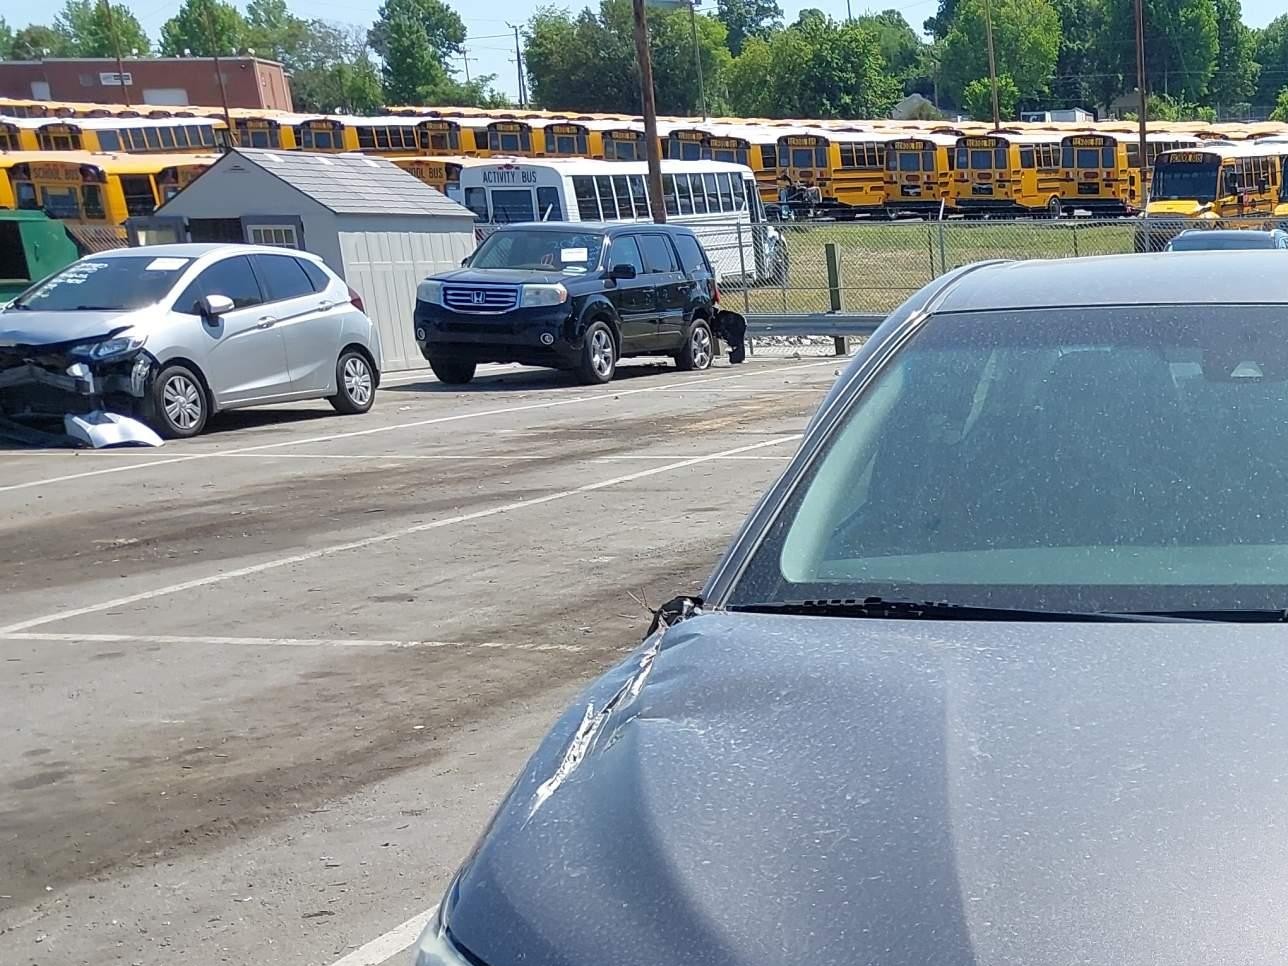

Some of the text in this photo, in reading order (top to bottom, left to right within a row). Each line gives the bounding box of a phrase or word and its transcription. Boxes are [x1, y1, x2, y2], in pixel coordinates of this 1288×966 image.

[428, 167, 444, 179] BUS
[483, 171, 537, 183] ACTIVITY BUS
